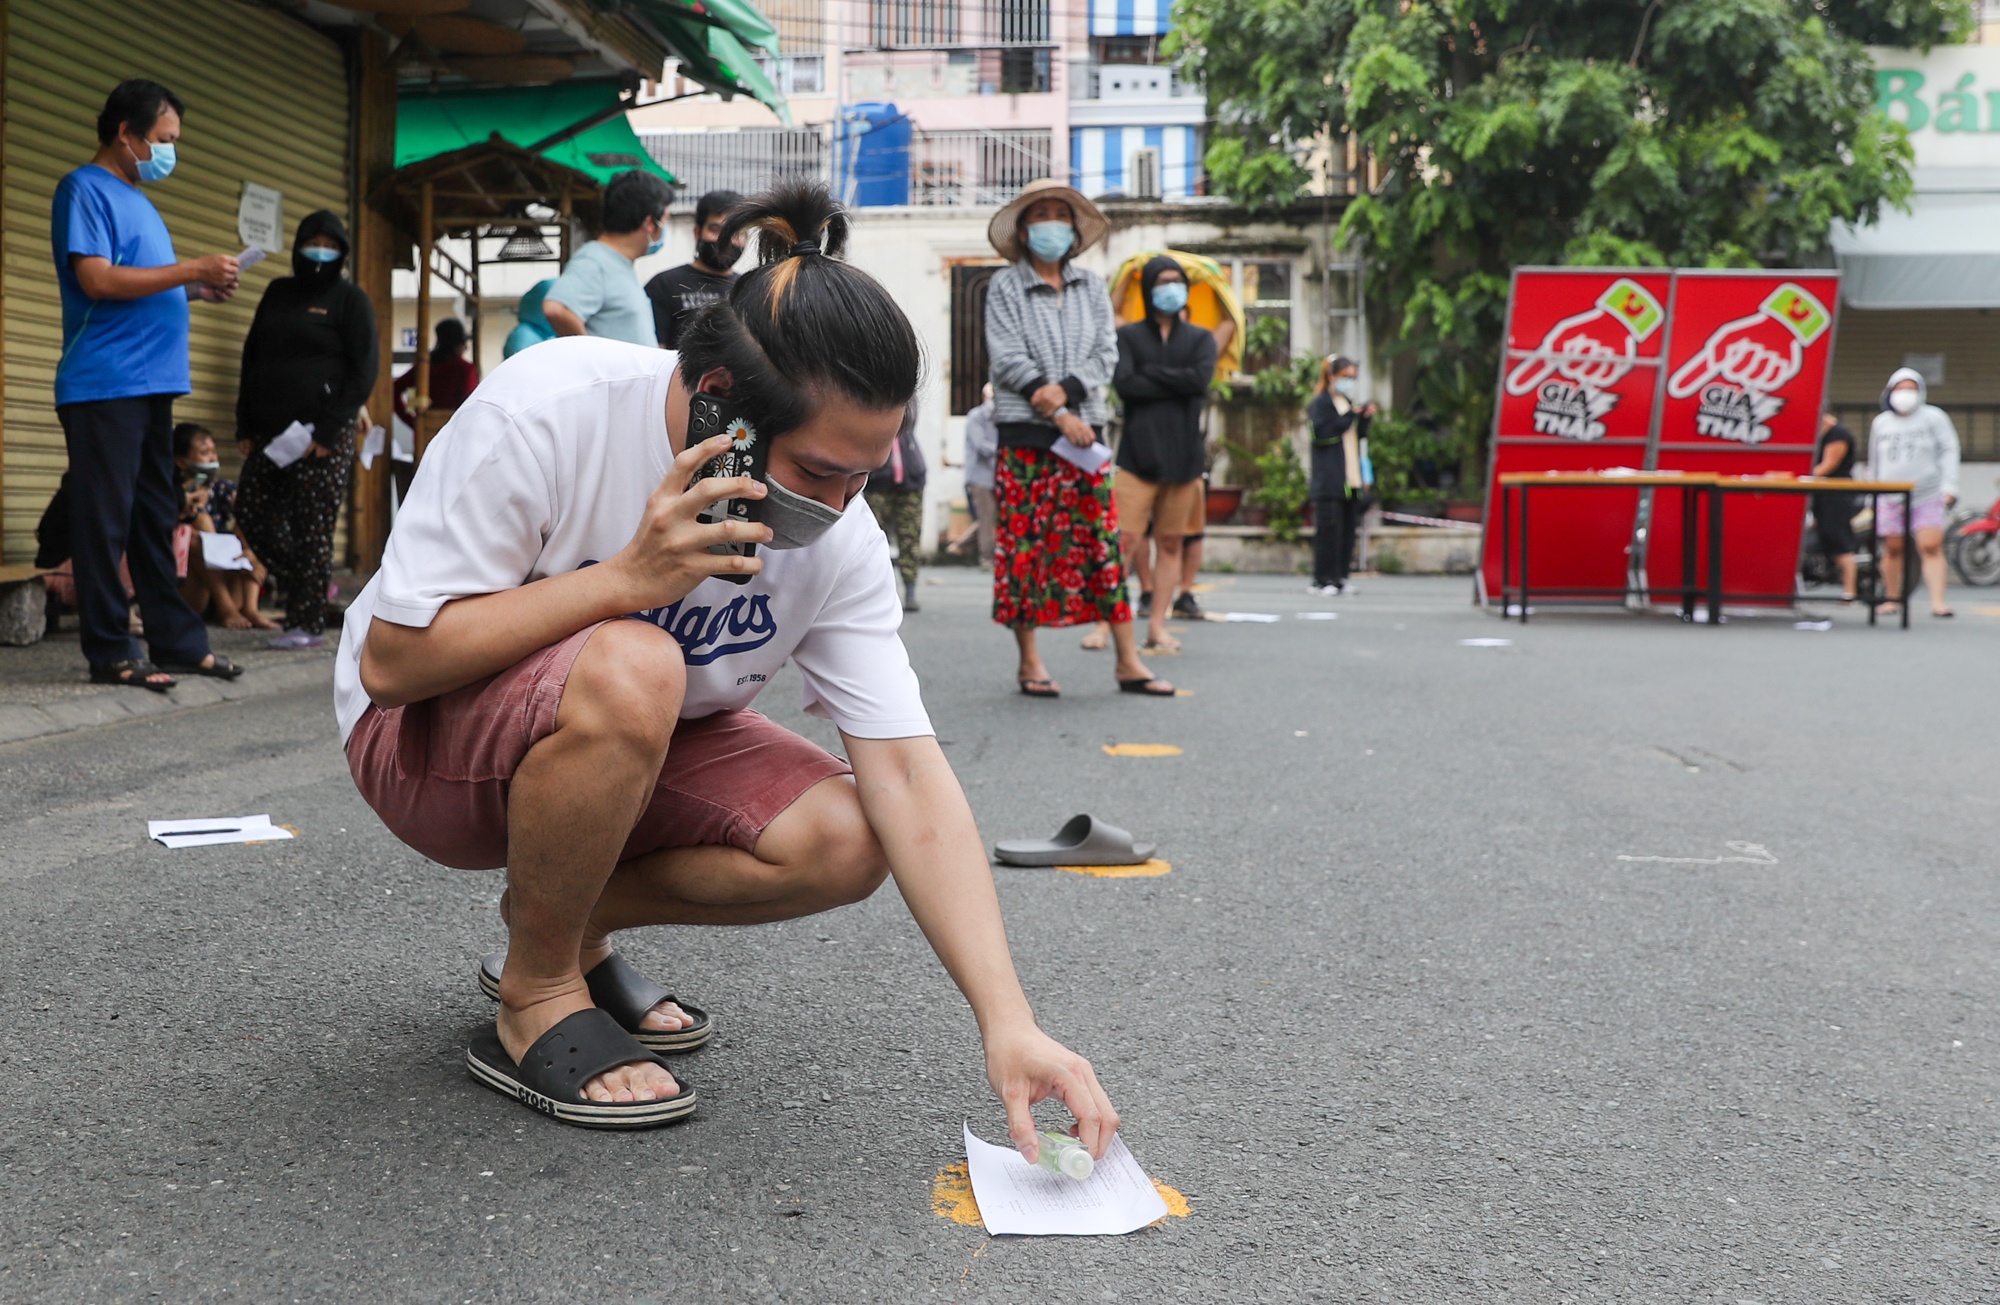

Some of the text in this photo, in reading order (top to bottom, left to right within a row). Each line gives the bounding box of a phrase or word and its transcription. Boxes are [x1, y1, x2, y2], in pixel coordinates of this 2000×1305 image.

[736, 673, 767, 686] EST. 1958
[518, 1086, 556, 1116] crocs
